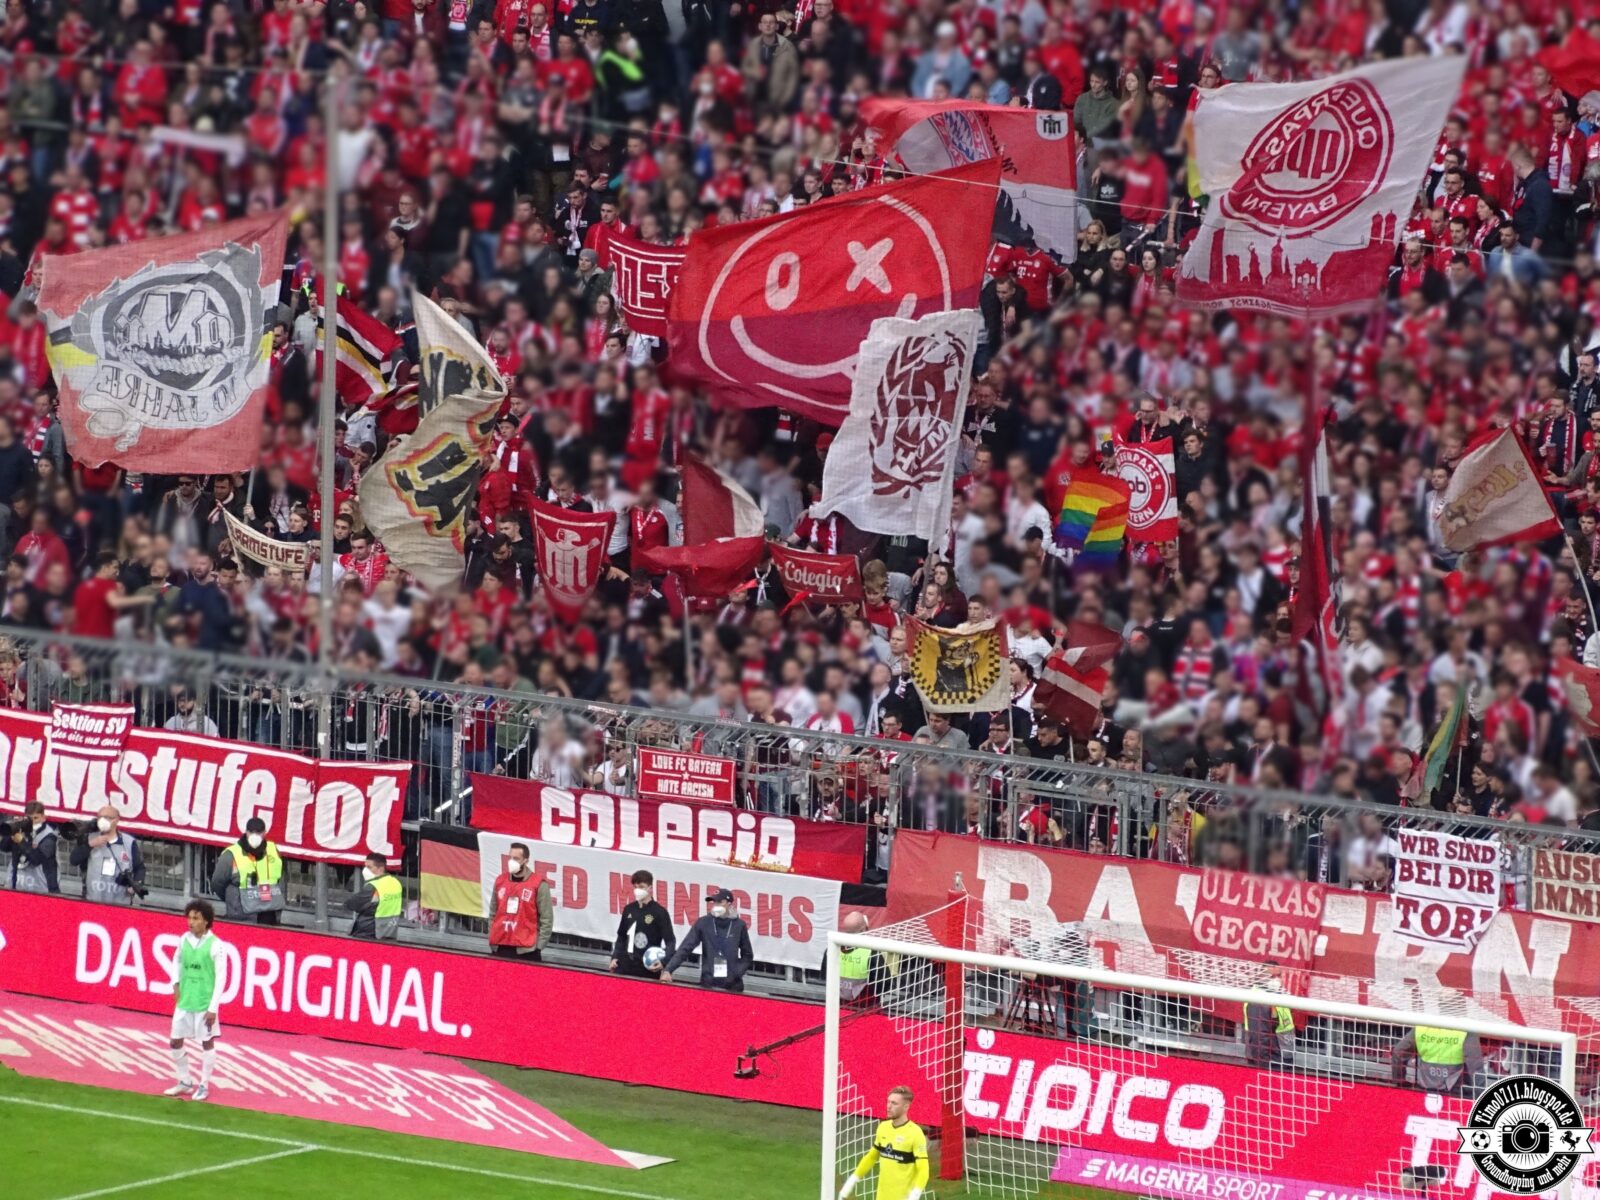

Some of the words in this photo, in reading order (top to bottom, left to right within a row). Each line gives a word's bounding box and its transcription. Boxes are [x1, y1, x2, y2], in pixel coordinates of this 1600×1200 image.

[784, 560, 842, 592] Colegio
[52, 708, 106, 734] Sektion
[652, 754, 674, 770] LOVE
[675, 757, 687, 771] FC
[687, 758, 723, 776] BAYERN
[657, 778, 680, 795] HATE
[680, 781, 714, 799] RACISM
[285, 775, 401, 857] rot
[1399, 833, 1440, 858] WIR
[1444, 839, 1496, 865] SIND
[1202, 866, 1323, 919] ULTRAS
[1398, 859, 1442, 888] BEI
[1448, 865, 1496, 895] DIR
[502, 920, 518, 933] TV
[1193, 910, 1318, 962] GEGEN
[75, 921, 180, 996] DAS
[1105, 1162, 1210, 1195] MAGENTA
[1211, 1178, 1285, 1200] SPORT
